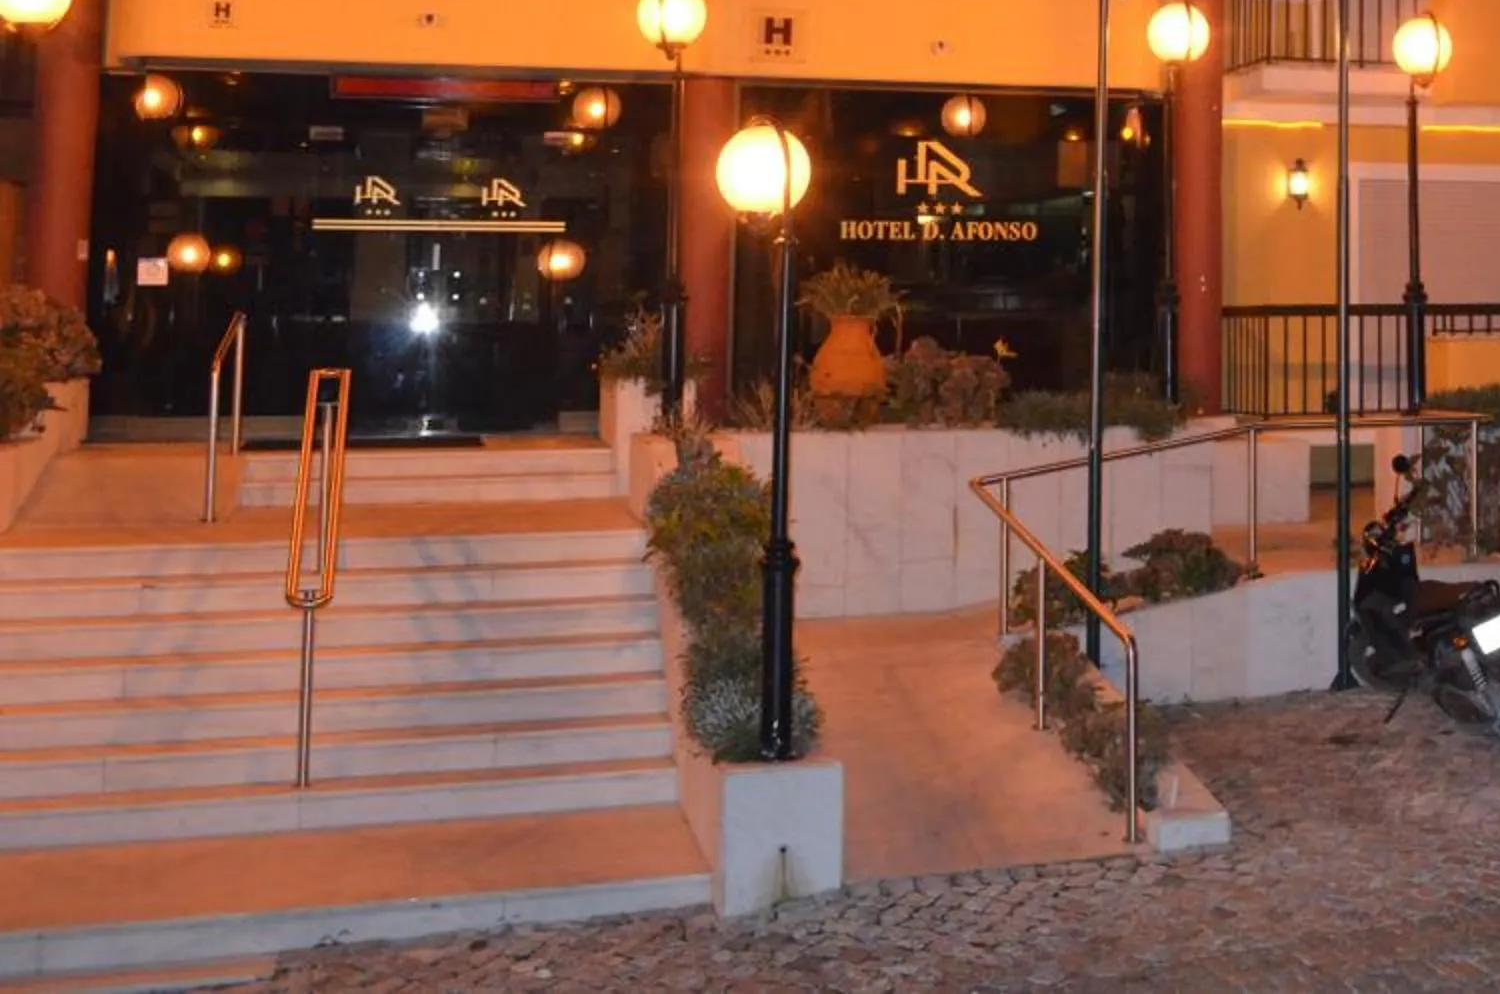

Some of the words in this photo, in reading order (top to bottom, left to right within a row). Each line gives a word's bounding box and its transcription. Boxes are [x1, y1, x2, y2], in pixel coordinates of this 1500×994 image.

[214, 1, 231, 18] H
[764, 17, 793, 46] H
[839, 220, 915, 241] HOTEL
[951, 220, 1038, 241] AFONSO
